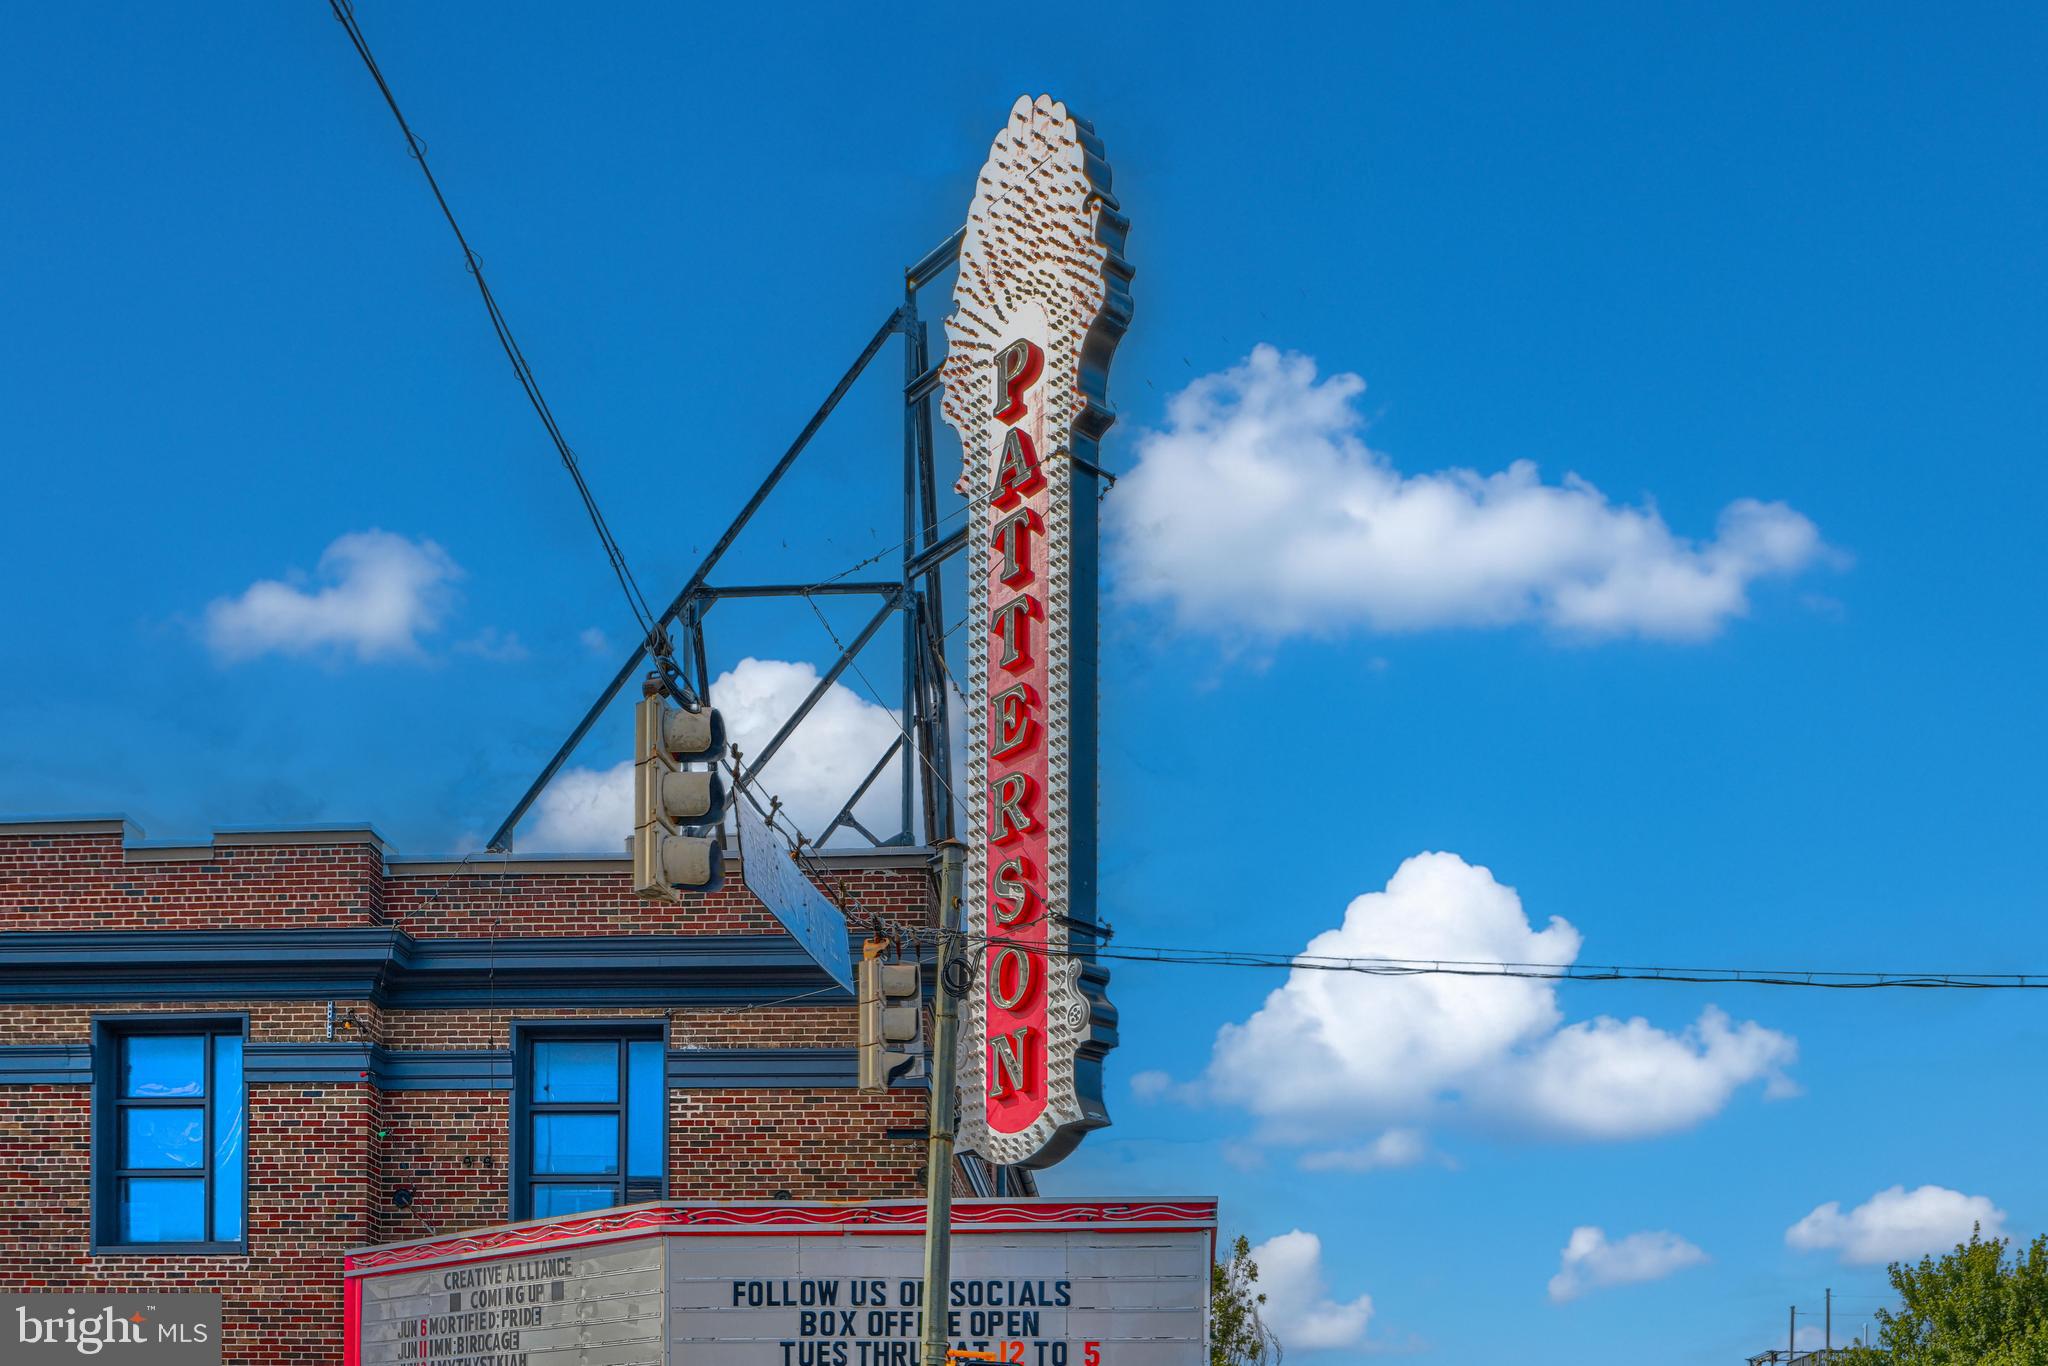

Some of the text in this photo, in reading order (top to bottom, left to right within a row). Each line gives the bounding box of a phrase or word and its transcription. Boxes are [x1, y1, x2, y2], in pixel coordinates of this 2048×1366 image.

[989, 338, 1045, 1103] PATTERSON
[444, 1257, 573, 1290] CREATIVE ALLIANCE
[471, 1283, 545, 1309] COMING UP
[733, 1281, 839, 1306] FOLLOW
[851, 1281, 886, 1306] US
[950, 1281, 1071, 1306] SOCIALS
[398, 1320, 418, 1337] JUN
[420, 1319, 428, 1337] 6
[800, 1311, 1040, 1336] BOX OFFIE OPEN
[398, 1341, 418, 1360] JUN
[780, 1341, 848, 1366] TUES
[1034, 1341, 1068, 1366] TO
[1084, 1341, 1101, 1366] 5
